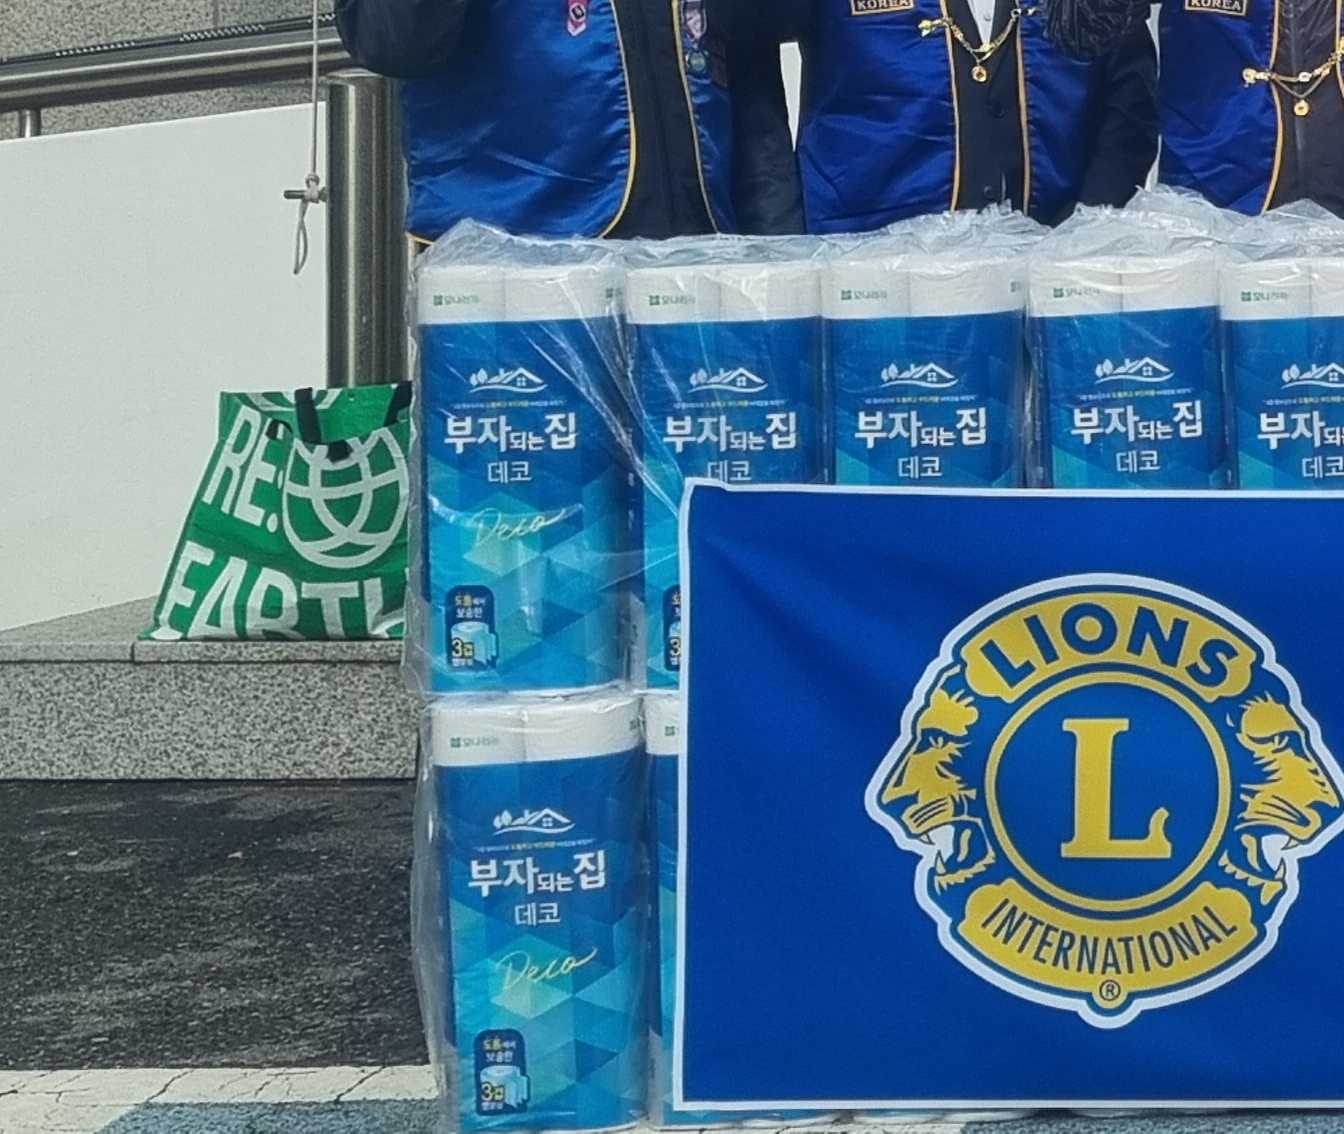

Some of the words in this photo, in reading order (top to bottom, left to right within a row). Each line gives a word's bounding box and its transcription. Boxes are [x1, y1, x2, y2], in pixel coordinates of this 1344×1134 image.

[444, 412, 577, 456] 부자되는집
[663, 411, 797, 454] 부자되는집
[855, 407, 987, 449] 부자되는집
[1071, 401, 1203, 445] 부자되는집
[487, 462, 532, 484] 데코
[707, 461, 752, 483] 데코
[898, 456, 943, 480] 데코
[1117, 451, 1161, 474] 데코
[979, 602, 1240, 690] LIONS
[1061, 718, 1172, 859] L
[467, 850, 607, 898] 부자되는집
[514, 902, 562, 926] 데코
[980, 898, 1239, 975] INTERNATIONAL
